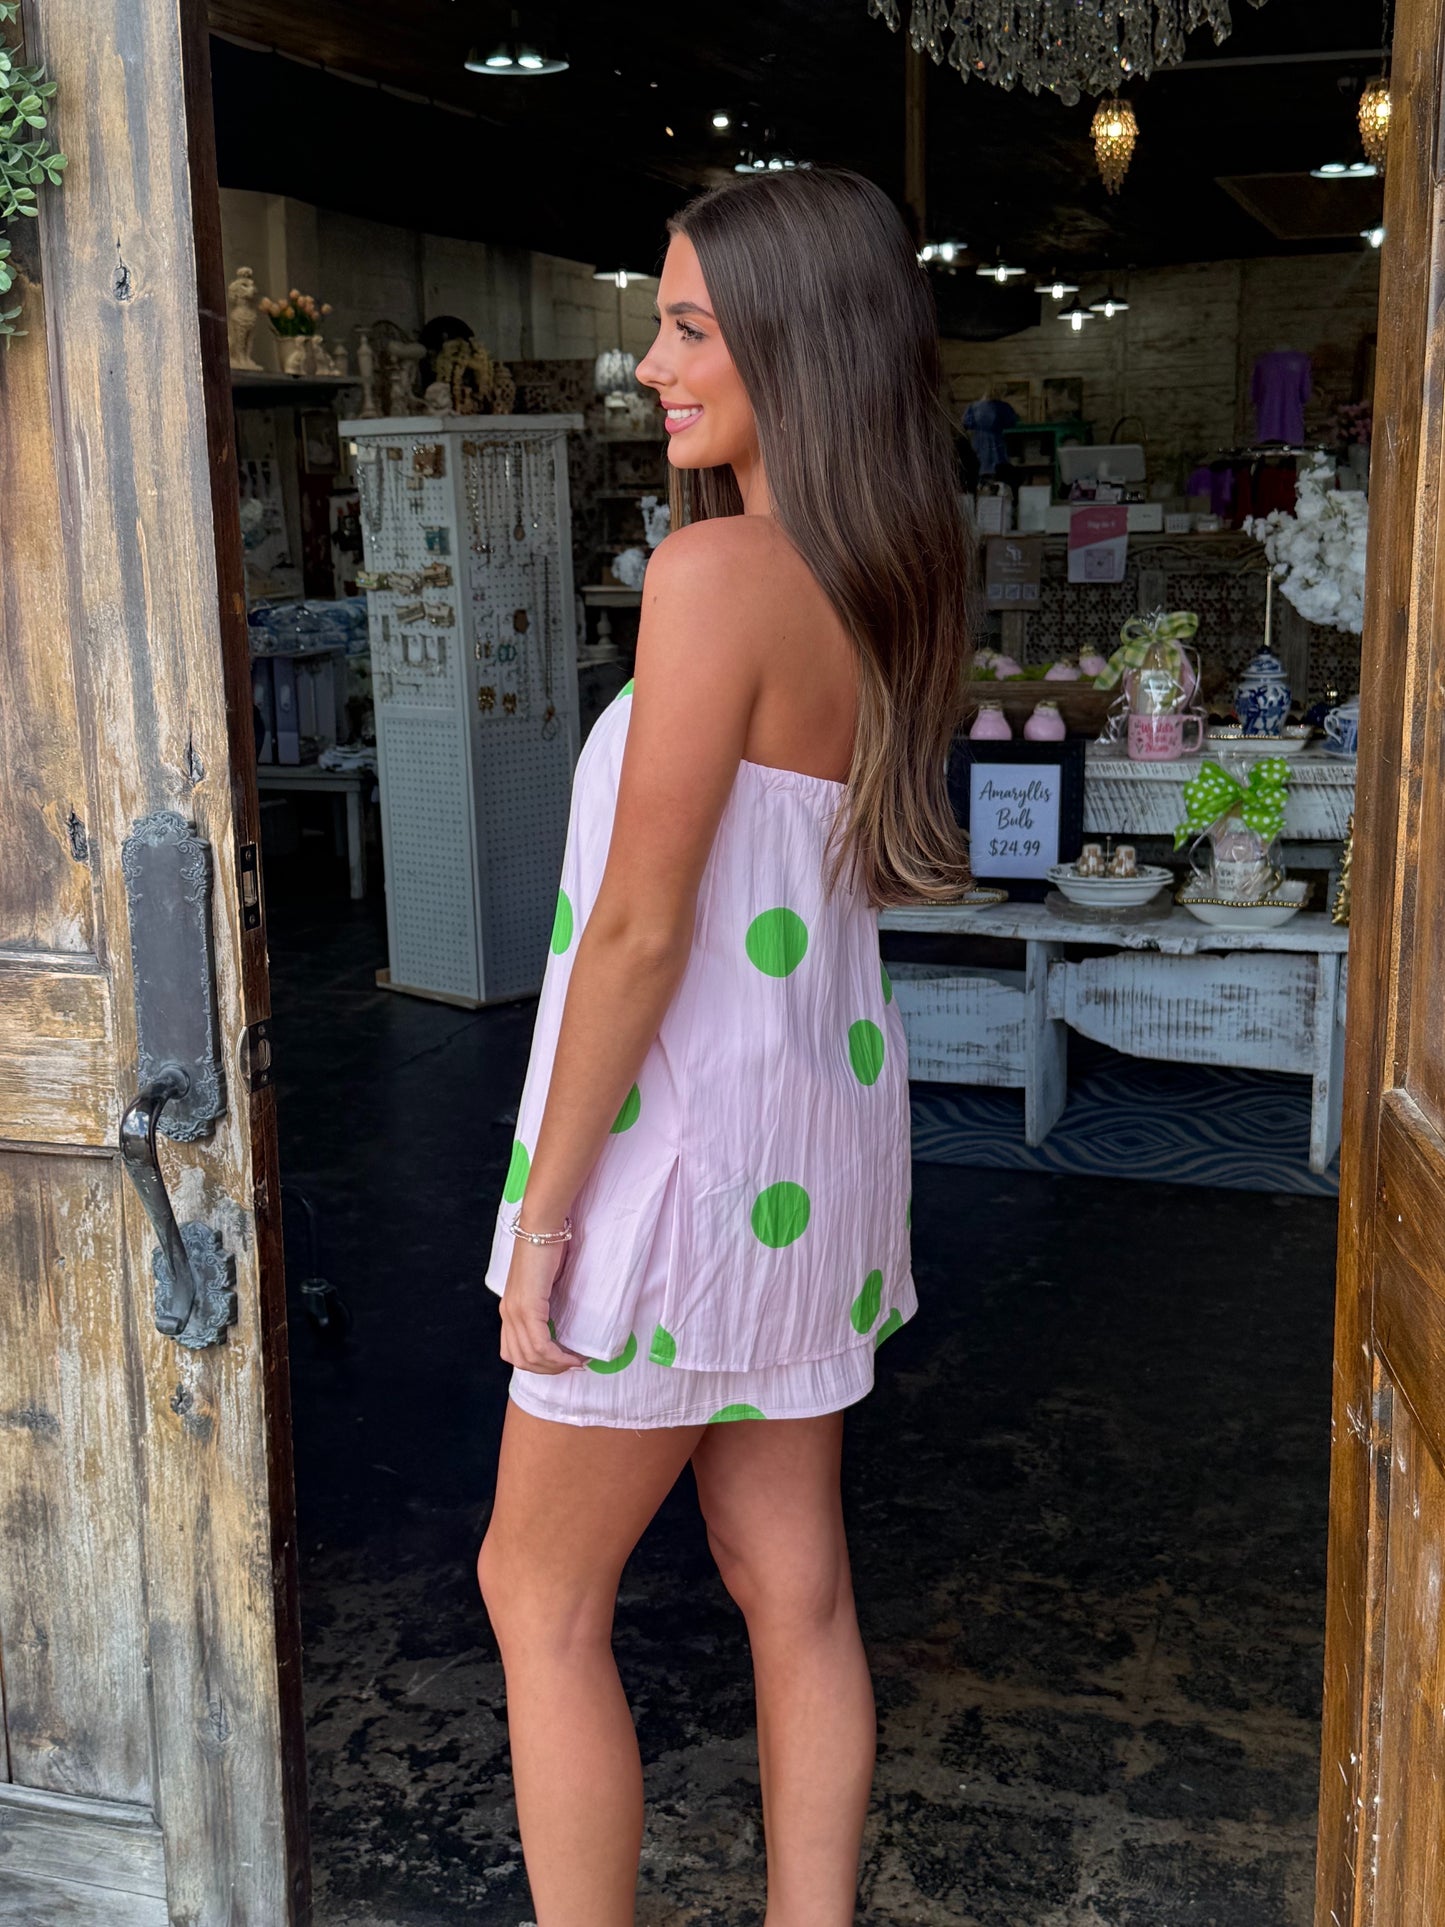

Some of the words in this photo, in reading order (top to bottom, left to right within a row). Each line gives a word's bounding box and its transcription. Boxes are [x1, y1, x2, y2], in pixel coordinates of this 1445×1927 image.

[979, 780, 1050, 808] Amaryllis
[996, 807, 1034, 830] Bulb
[988, 838, 1040, 856] $24.99
